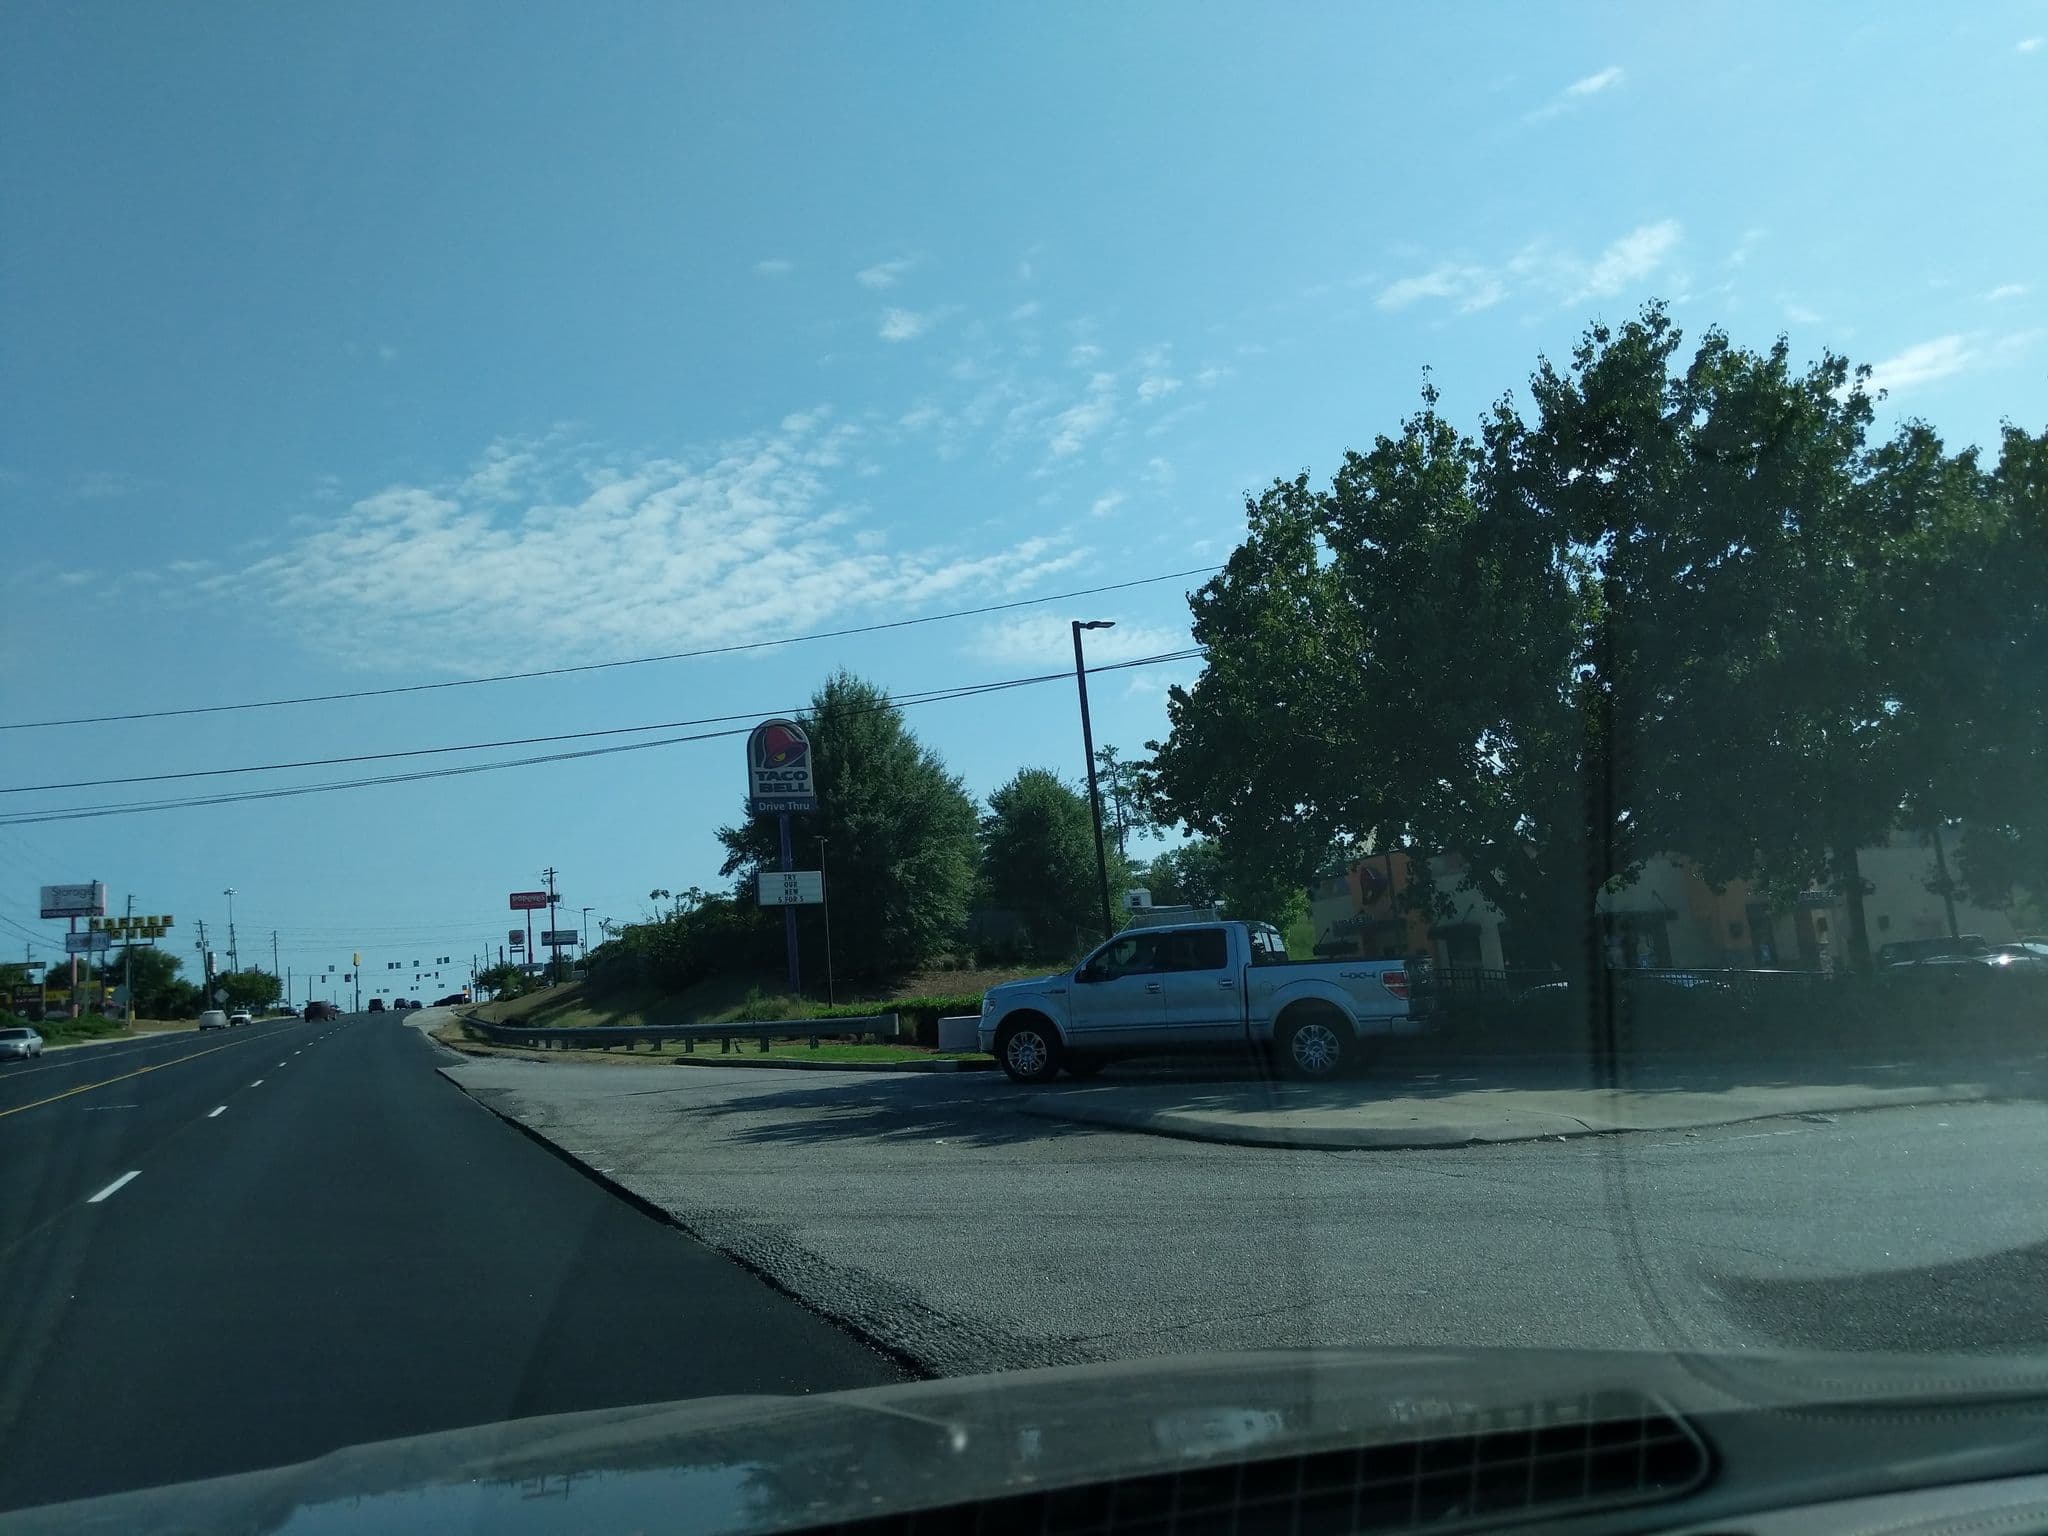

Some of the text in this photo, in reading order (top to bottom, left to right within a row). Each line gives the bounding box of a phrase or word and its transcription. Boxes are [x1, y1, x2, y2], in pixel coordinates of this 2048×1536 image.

[754, 771, 808, 781] TACO
[759, 783, 810, 793] BELL
[759, 801, 810, 811] Drive Thru
